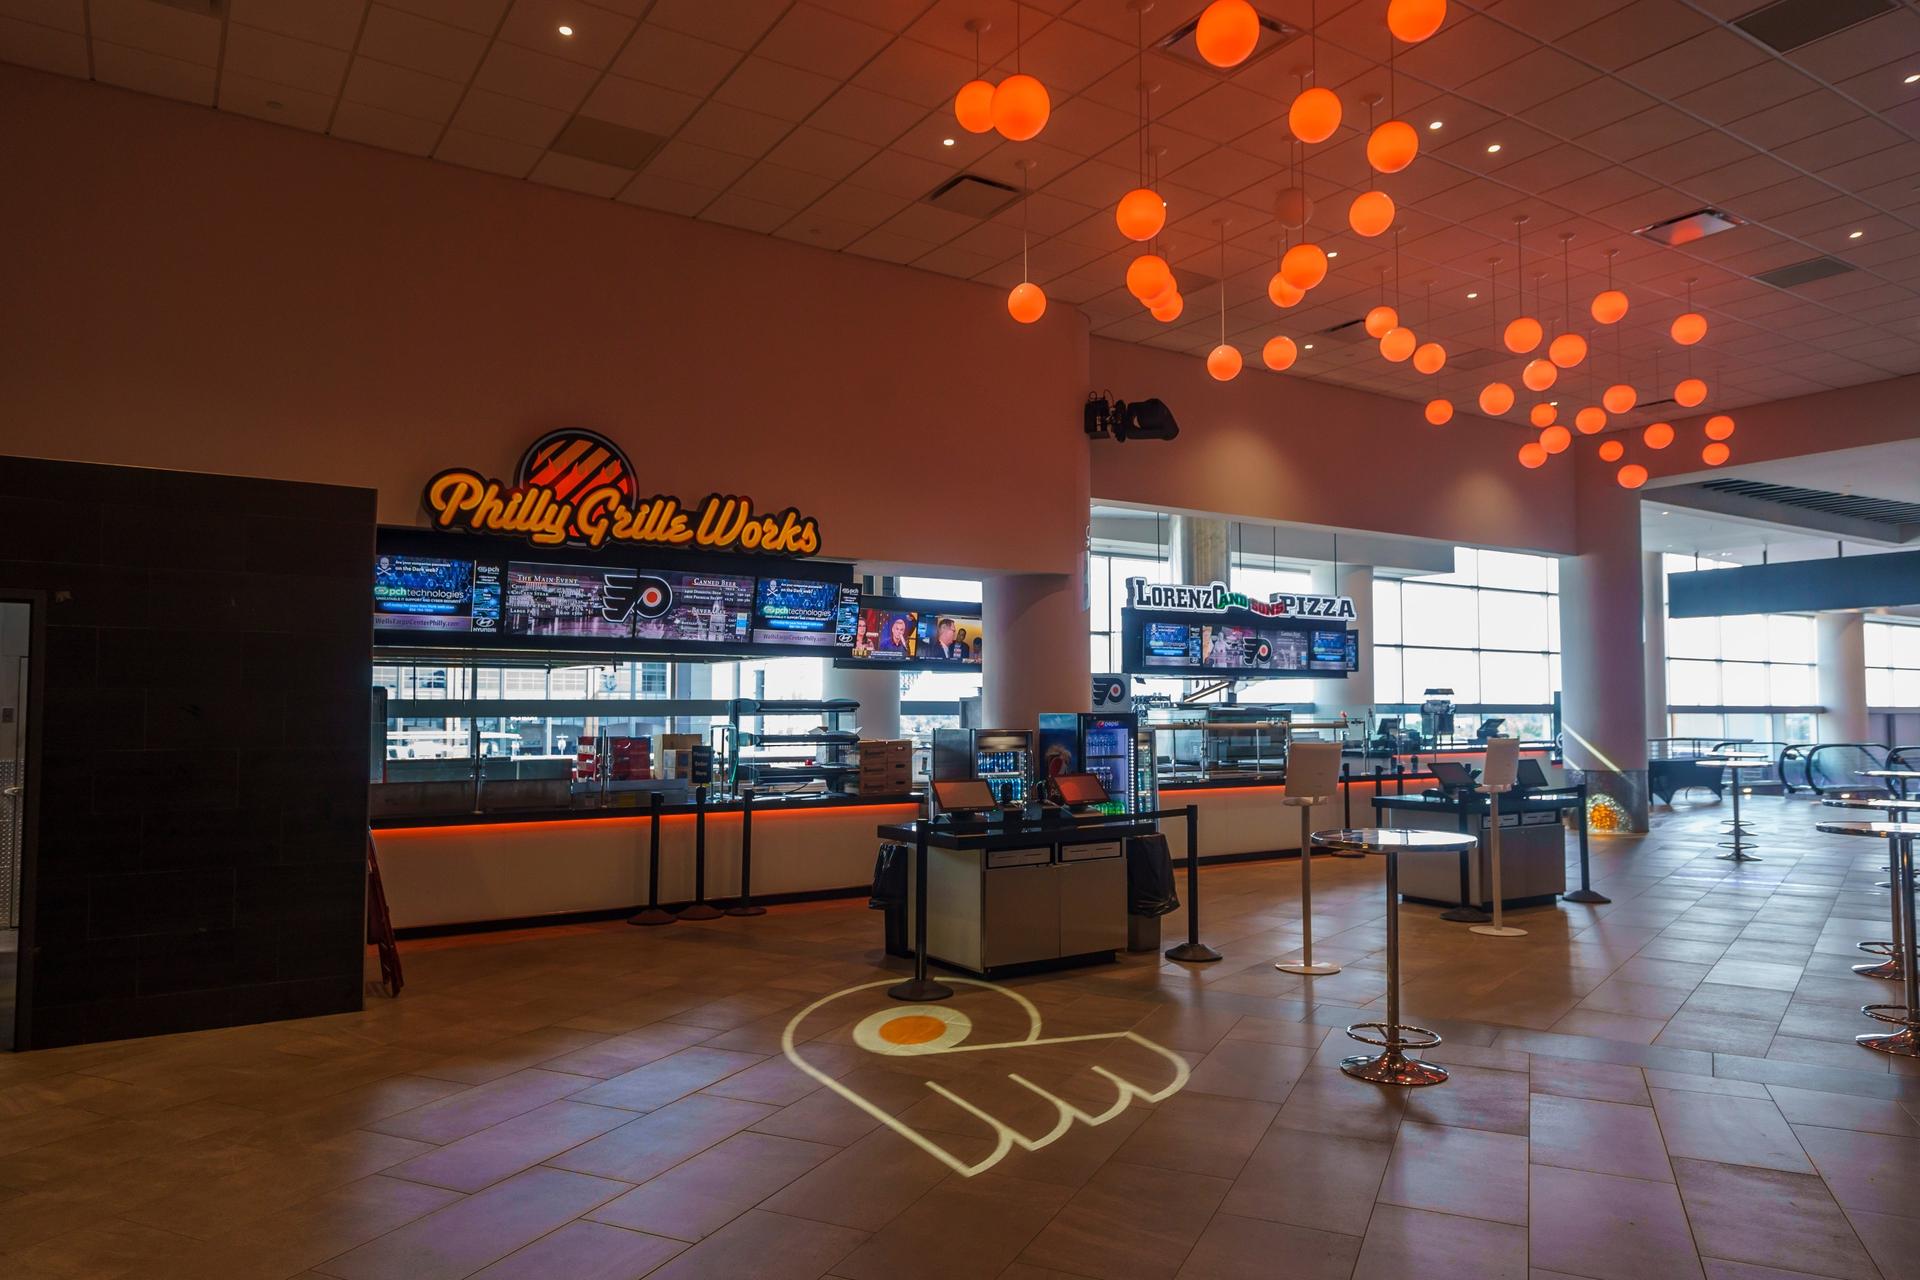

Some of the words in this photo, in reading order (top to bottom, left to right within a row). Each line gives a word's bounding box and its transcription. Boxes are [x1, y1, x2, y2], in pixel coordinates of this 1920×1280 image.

[429, 472, 572, 544] Philly
[576, 486, 694, 546] Grille
[695, 498, 818, 553] Works
[407, 588, 464, 600] technologies
[1134, 579, 1225, 610] LORENZO
[1217, 592, 1250, 609] AND
[1250, 599, 1285, 617] SONS
[1278, 595, 1355, 618] PIZZA
[788, 608, 831, 618] technologies
